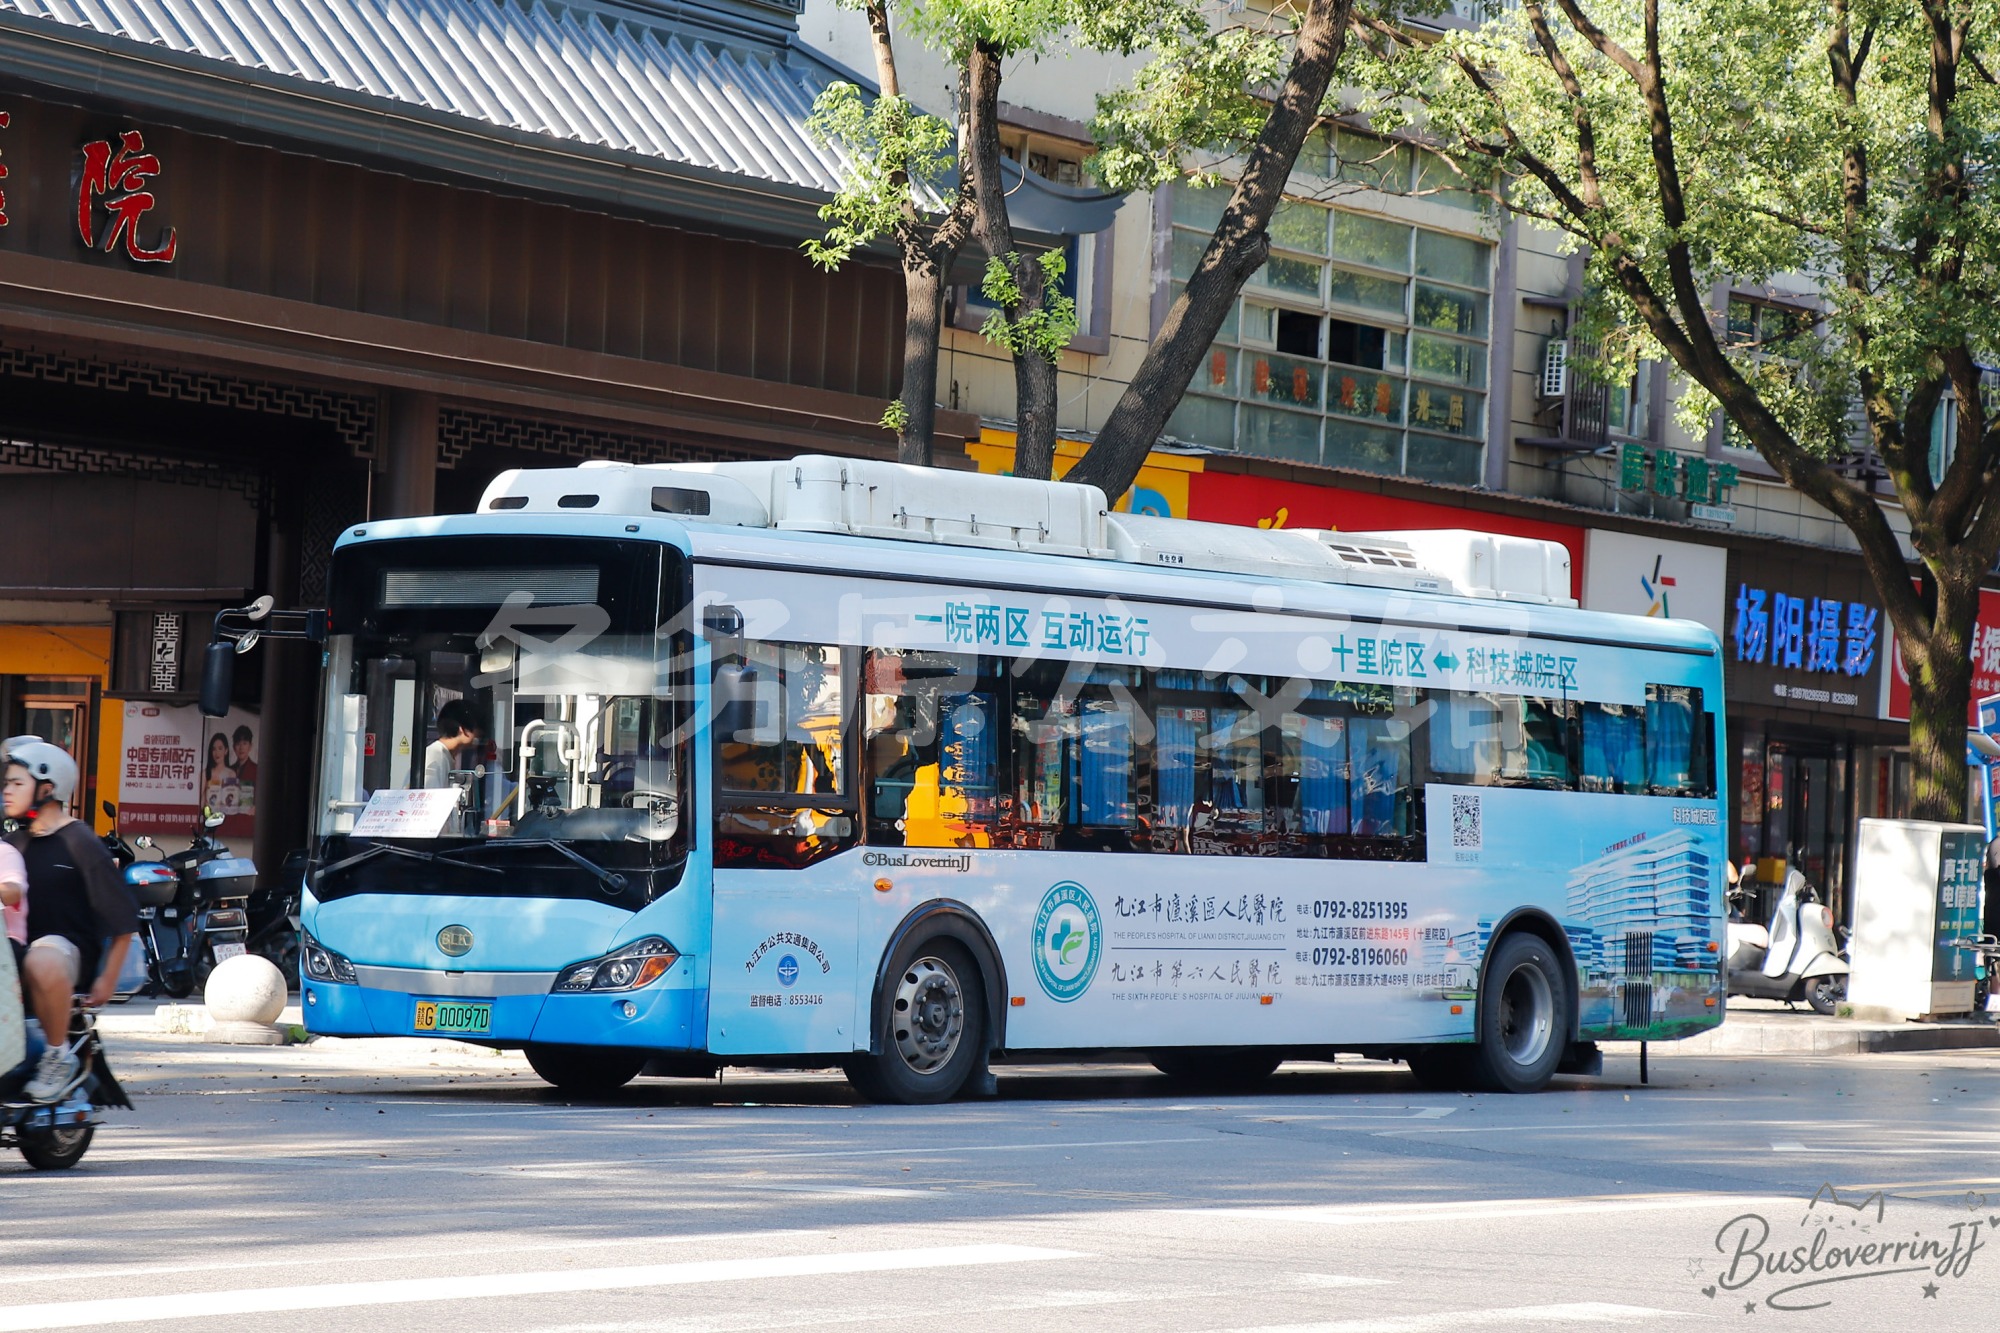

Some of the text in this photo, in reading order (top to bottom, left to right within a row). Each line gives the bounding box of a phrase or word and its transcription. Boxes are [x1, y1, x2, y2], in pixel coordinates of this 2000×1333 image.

[914, 601, 1150, 657] 一院两区 互动运行
[1735, 583, 1878, 676] 杨阳摄影
[1332, 634, 1579, 691] 十里院区 科技城院区
[126, 747, 195, 764] 中国专利配方
[126, 763, 195, 780] 宝宝超凡守护
[1673, 807, 1717, 825] 科技城院区
[1114, 931, 1126, 940] THE
[1127, 931, 1156, 940] PEOPLE'S
[1158, 932, 1187, 940] HOSPITAL
[1188, 932, 1197, 940] OF
[1198, 932, 1217, 941] LIANXI
[1273, 933, 1286, 941] CITY
[745, 931, 831, 974] 九江市公共交通集团公司
[1112, 993, 1125, 1001] THE
[1127, 993, 1148, 1001] SIXTH
[1189, 993, 1222, 1001] HOSPITAL
[1224, 993, 1234, 1001] OF
